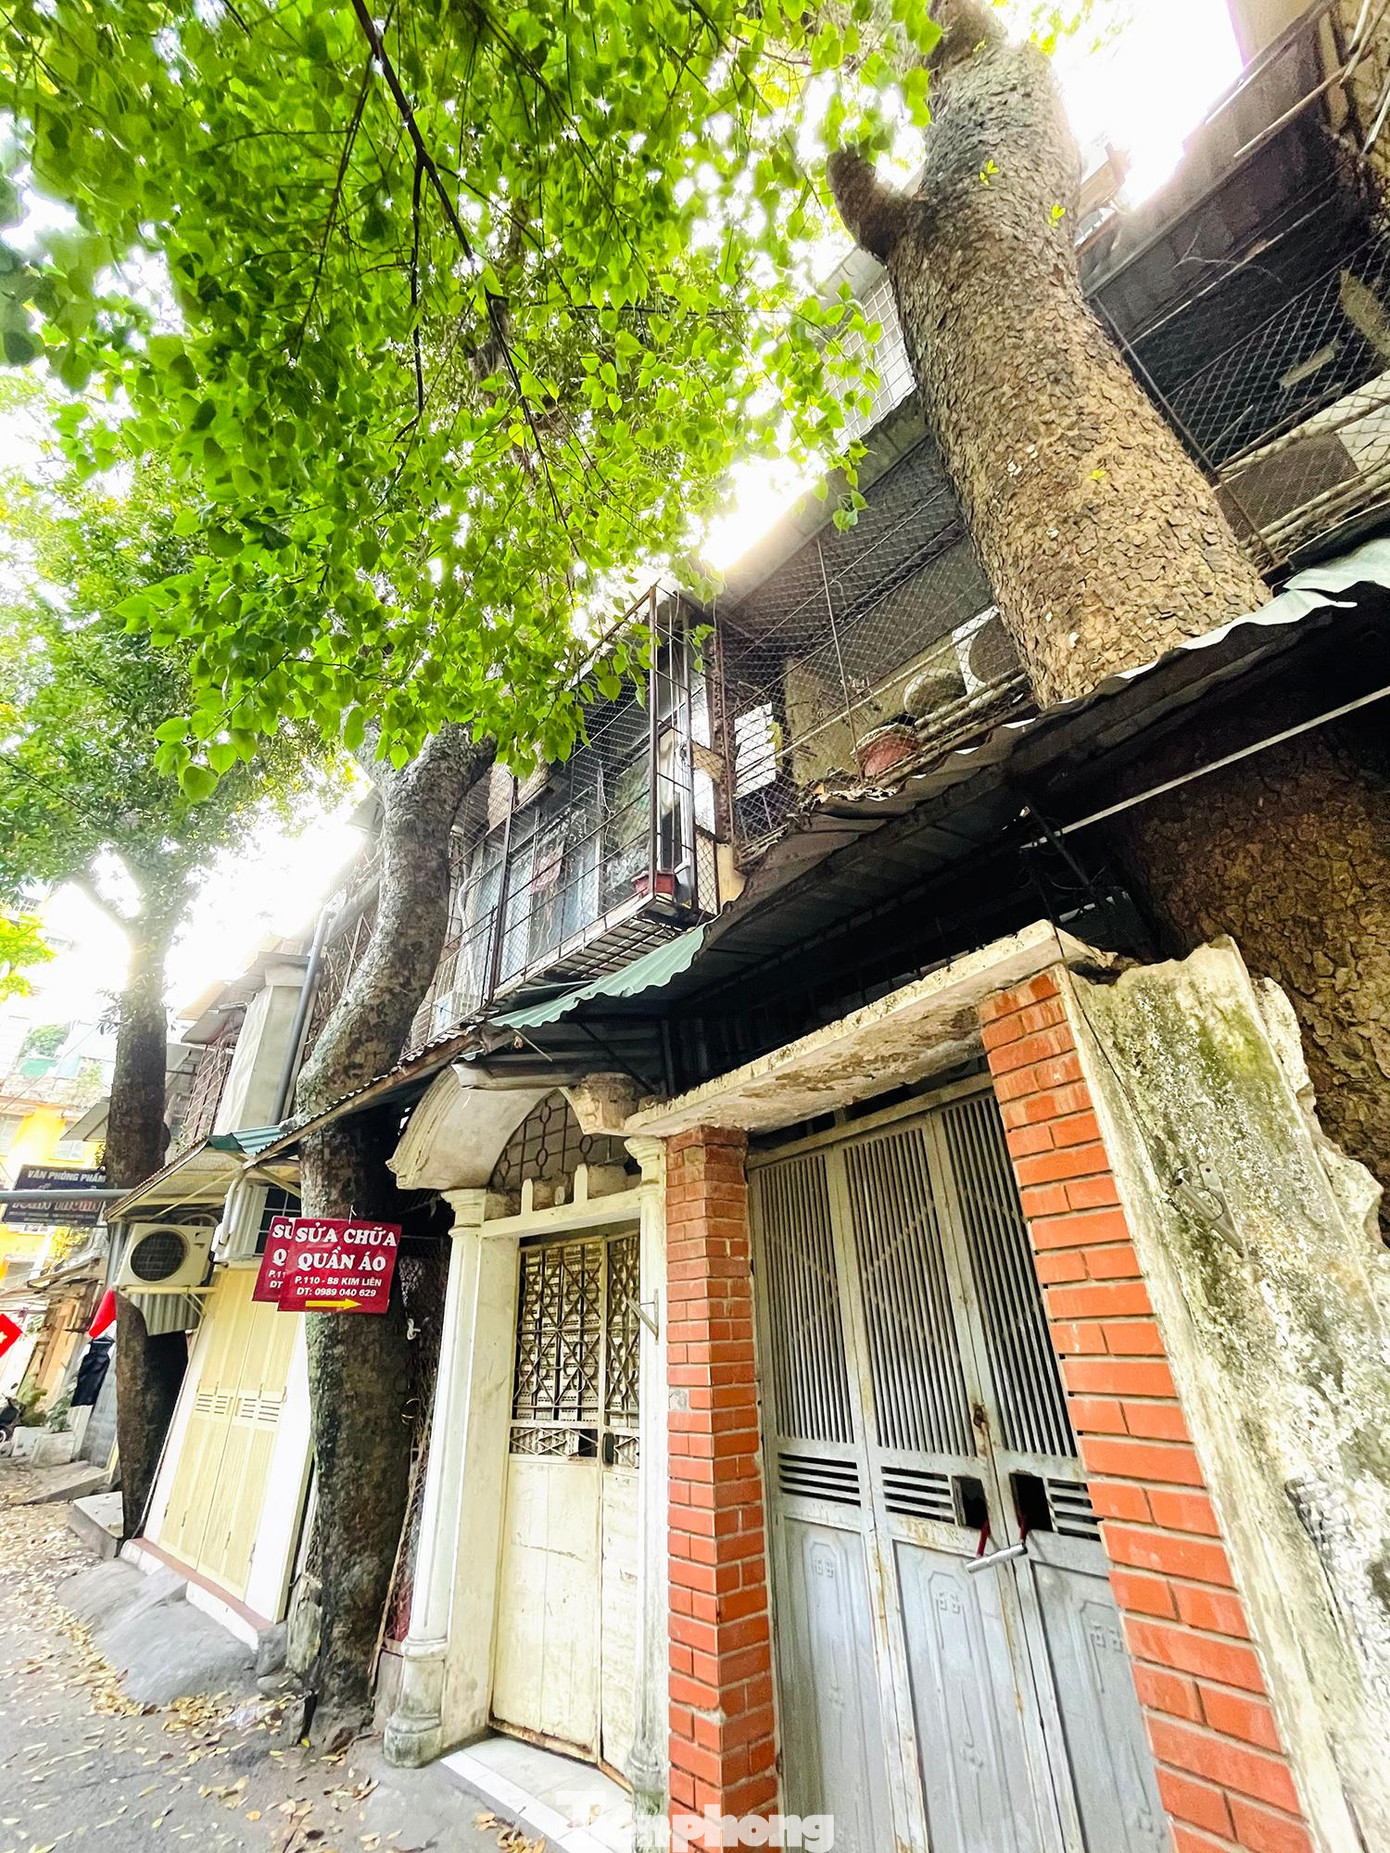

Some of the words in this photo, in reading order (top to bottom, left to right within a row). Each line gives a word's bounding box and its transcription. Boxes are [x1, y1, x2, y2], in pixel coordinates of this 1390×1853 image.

[295, 1221, 338, 1243] SỬA
[343, 1226, 397, 1247] CHỮA
[298, 1246, 355, 1271] QUẦN
[357, 1251, 386, 1271] ÁO
[341, 1277, 360, 1286] KIM
[362, 1277, 382, 1287] LIÊN
[314, 1288, 337, 1296] 0989
[338, 1288, 357, 1297] 040
[359, 1289, 377, 1297] 629
